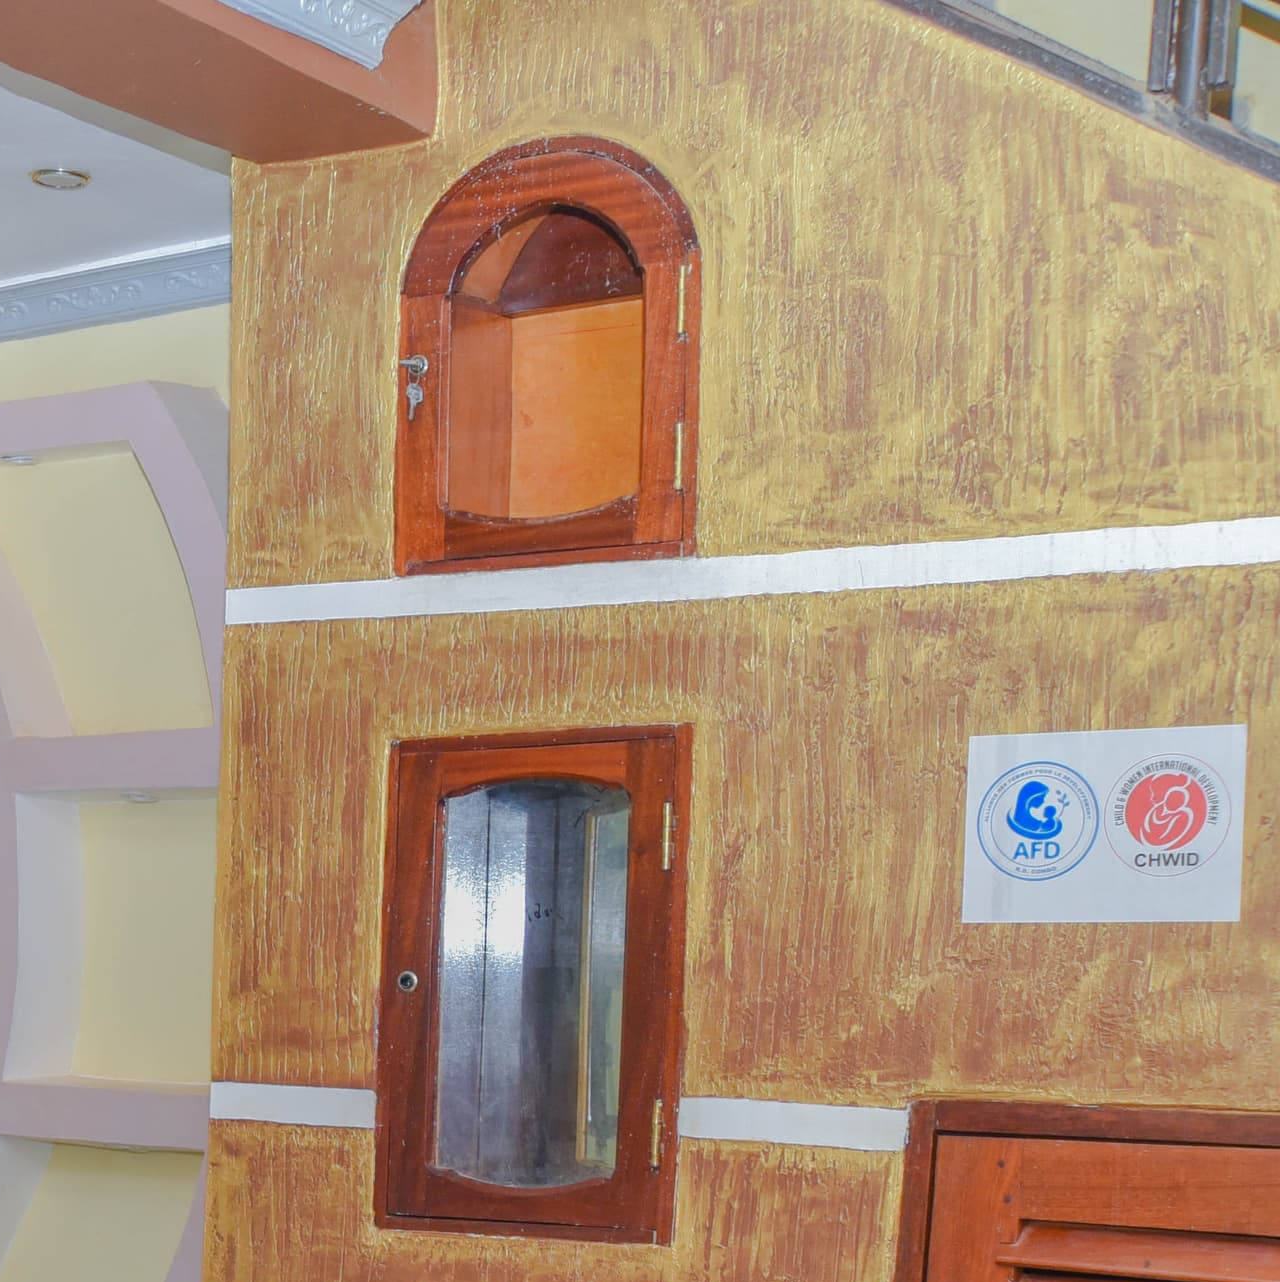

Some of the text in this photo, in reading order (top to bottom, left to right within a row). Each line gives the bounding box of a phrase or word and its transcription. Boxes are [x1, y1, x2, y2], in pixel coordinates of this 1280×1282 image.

[1114, 804, 1124, 826] CHILD
[1120, 770, 1143, 796] WOMEN
[1142, 760, 1201, 776] INTERNATIONAL
[1199, 774, 1219, 825] DEVELOPMENT
[1013, 841, 1061, 860] AFD
[1134, 852, 1200, 868] CHWID
